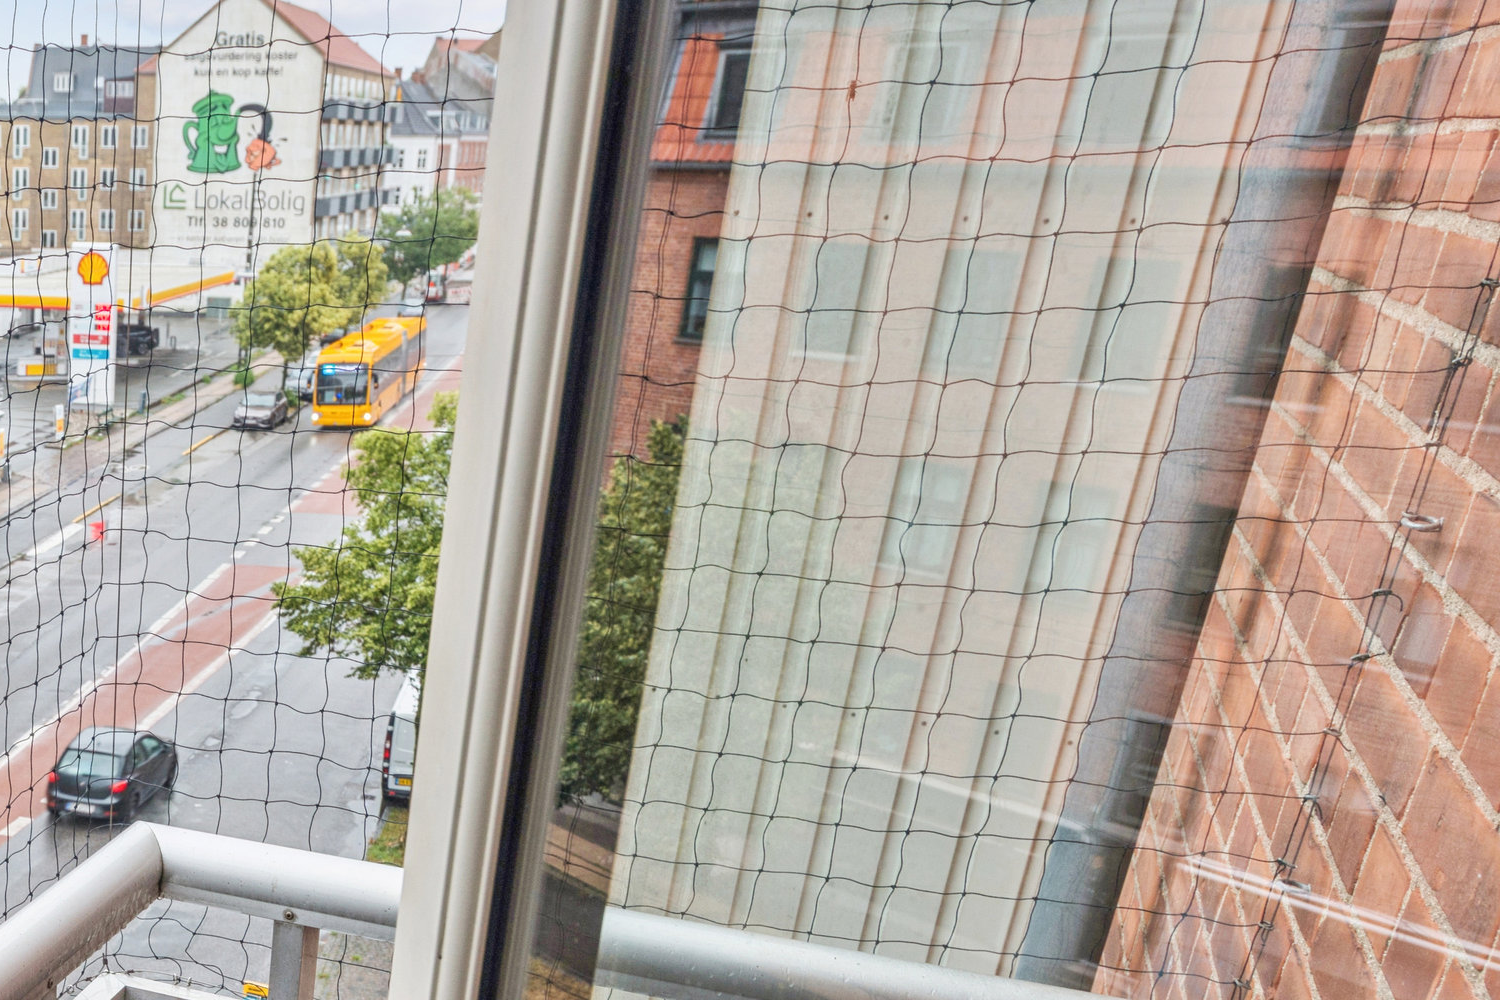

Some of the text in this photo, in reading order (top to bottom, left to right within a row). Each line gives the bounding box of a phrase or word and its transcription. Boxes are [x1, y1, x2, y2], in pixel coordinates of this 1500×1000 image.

[216, 31, 265, 46] Gratis
[232, 66, 251, 79] kop
[194, 188, 306, 216] LokalBolig
[212, 216, 228, 228] 38
[263, 217, 285, 228] 810
